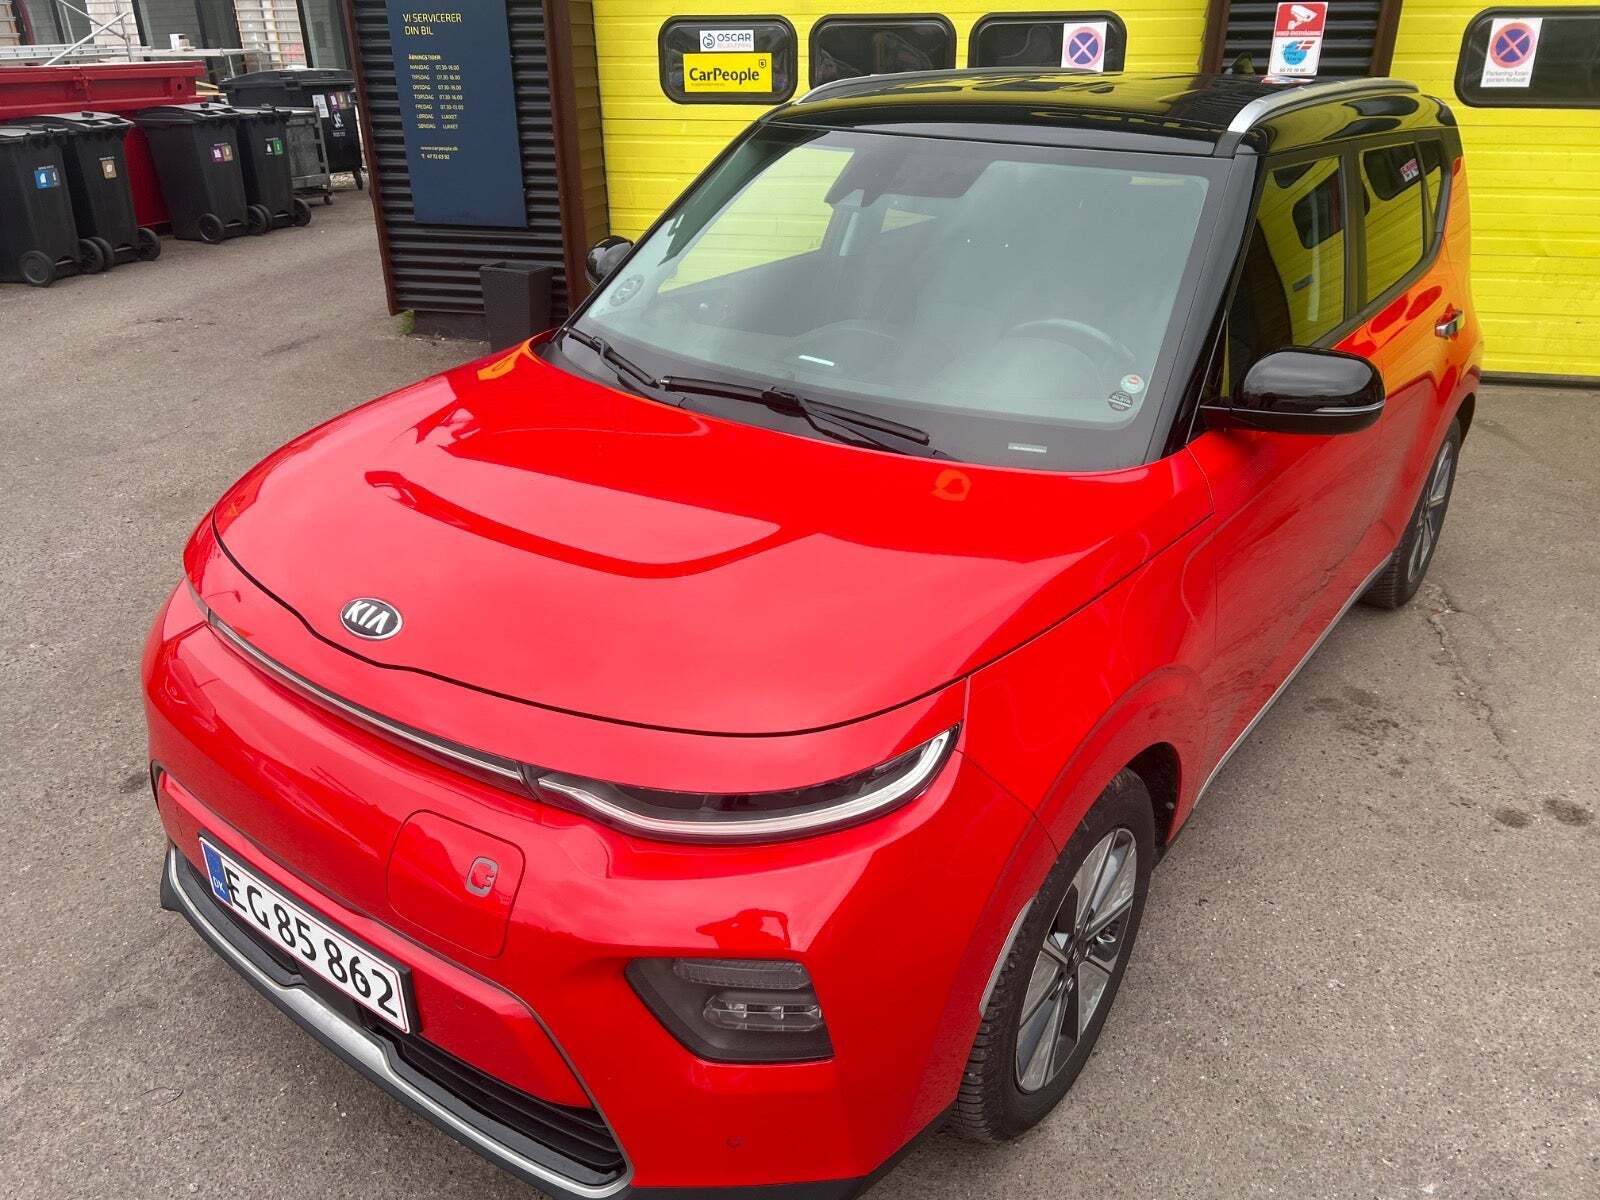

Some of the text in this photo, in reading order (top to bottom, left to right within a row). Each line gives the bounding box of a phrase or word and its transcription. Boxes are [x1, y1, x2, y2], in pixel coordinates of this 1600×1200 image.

[402, 13, 462, 23] VI SERVICERER
[404, 26, 434, 35] DIN BIL
[717, 33, 752, 42] OSCAR
[689, 67, 760, 85] CarPeople
[344, 600, 390, 634] KIA
[212, 876, 226, 894] DK
[224, 866, 399, 1019] EG 85 862
